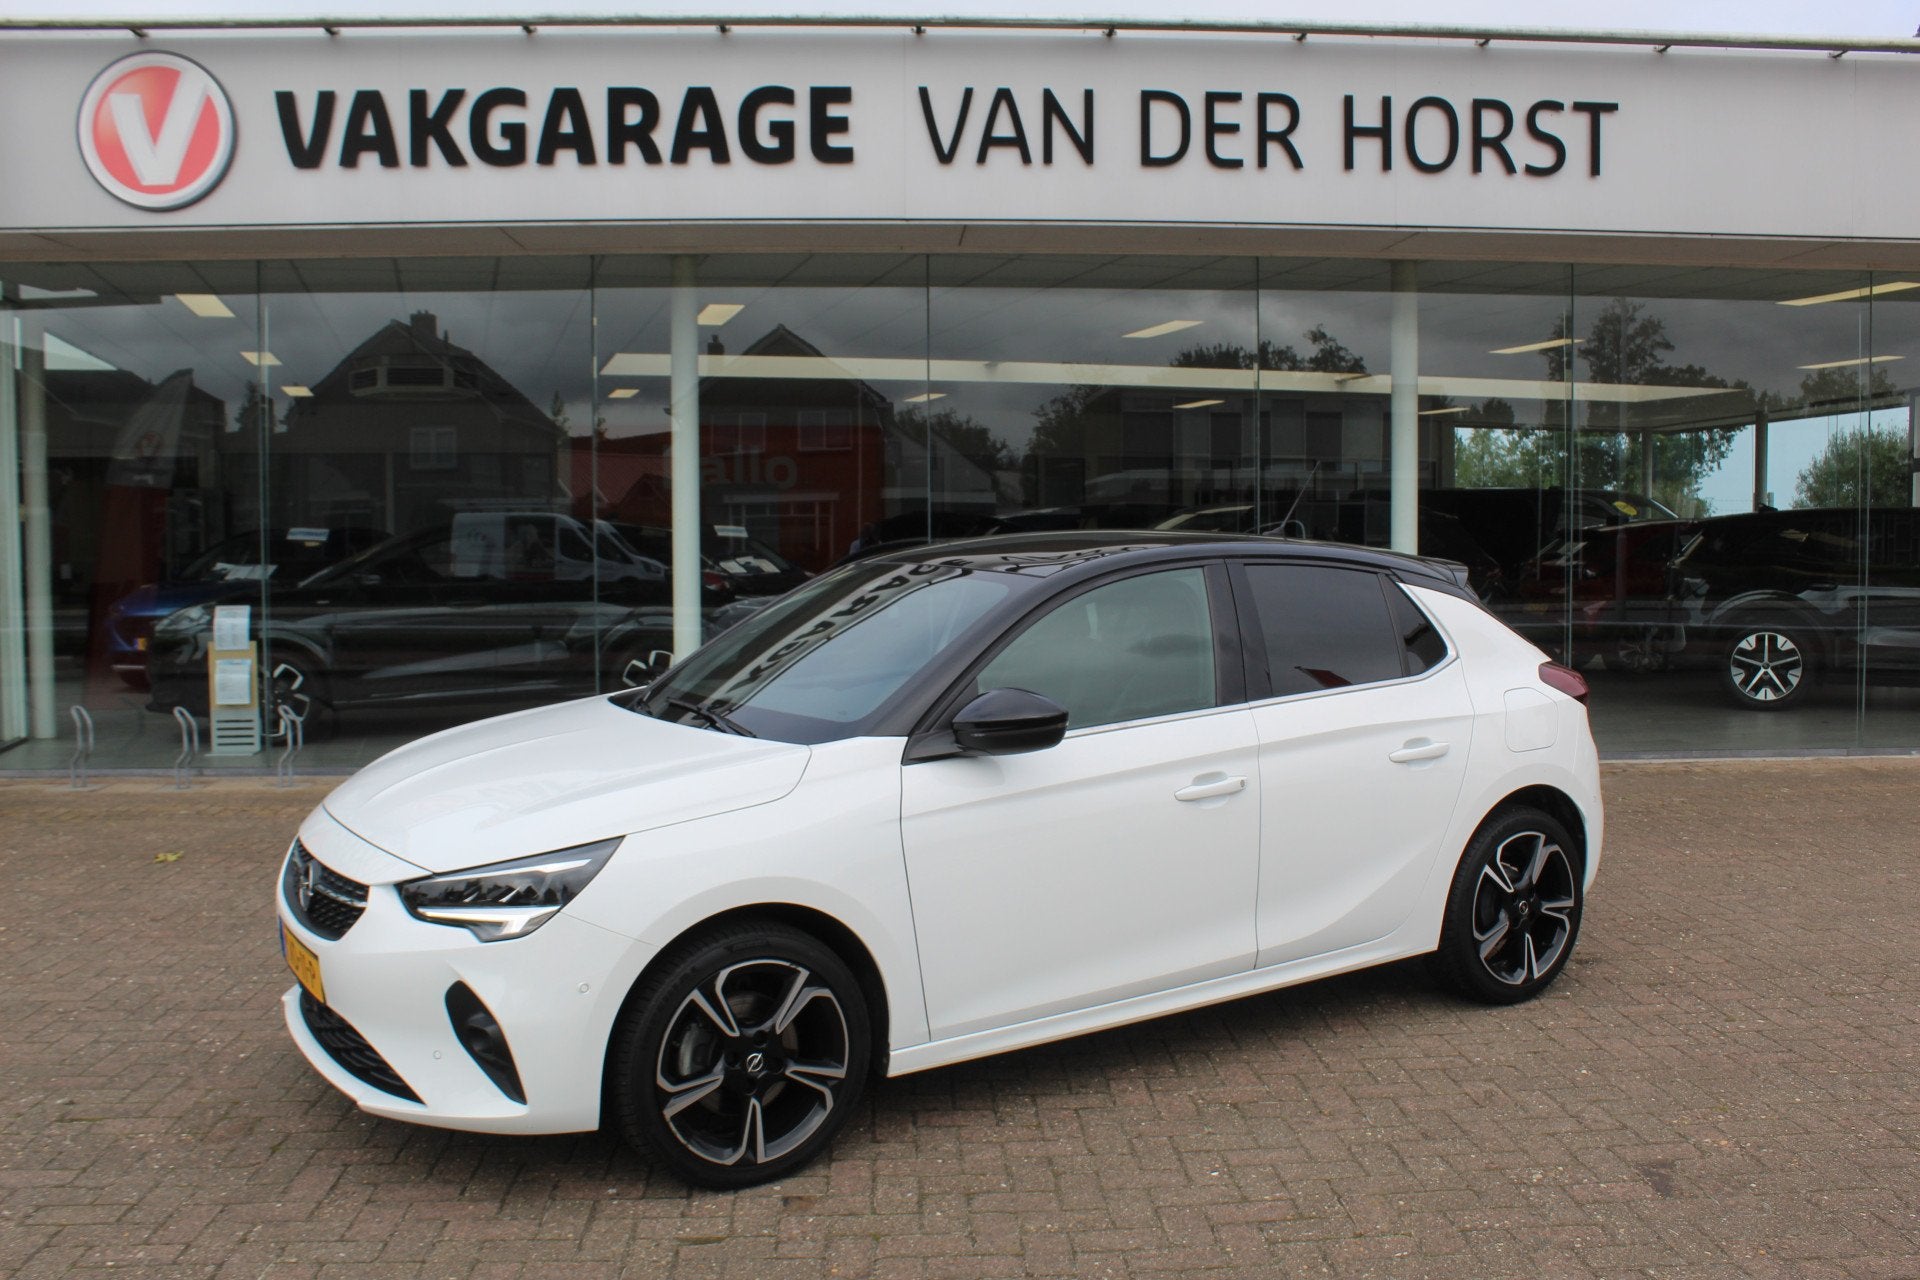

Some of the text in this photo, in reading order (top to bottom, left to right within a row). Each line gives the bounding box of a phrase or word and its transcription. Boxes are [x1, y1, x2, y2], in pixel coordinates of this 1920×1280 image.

[107, 66, 209, 186] V
[275, 86, 1619, 177] VAKGARAGE VAN DER HORST
[663, 442, 798, 489] allo
